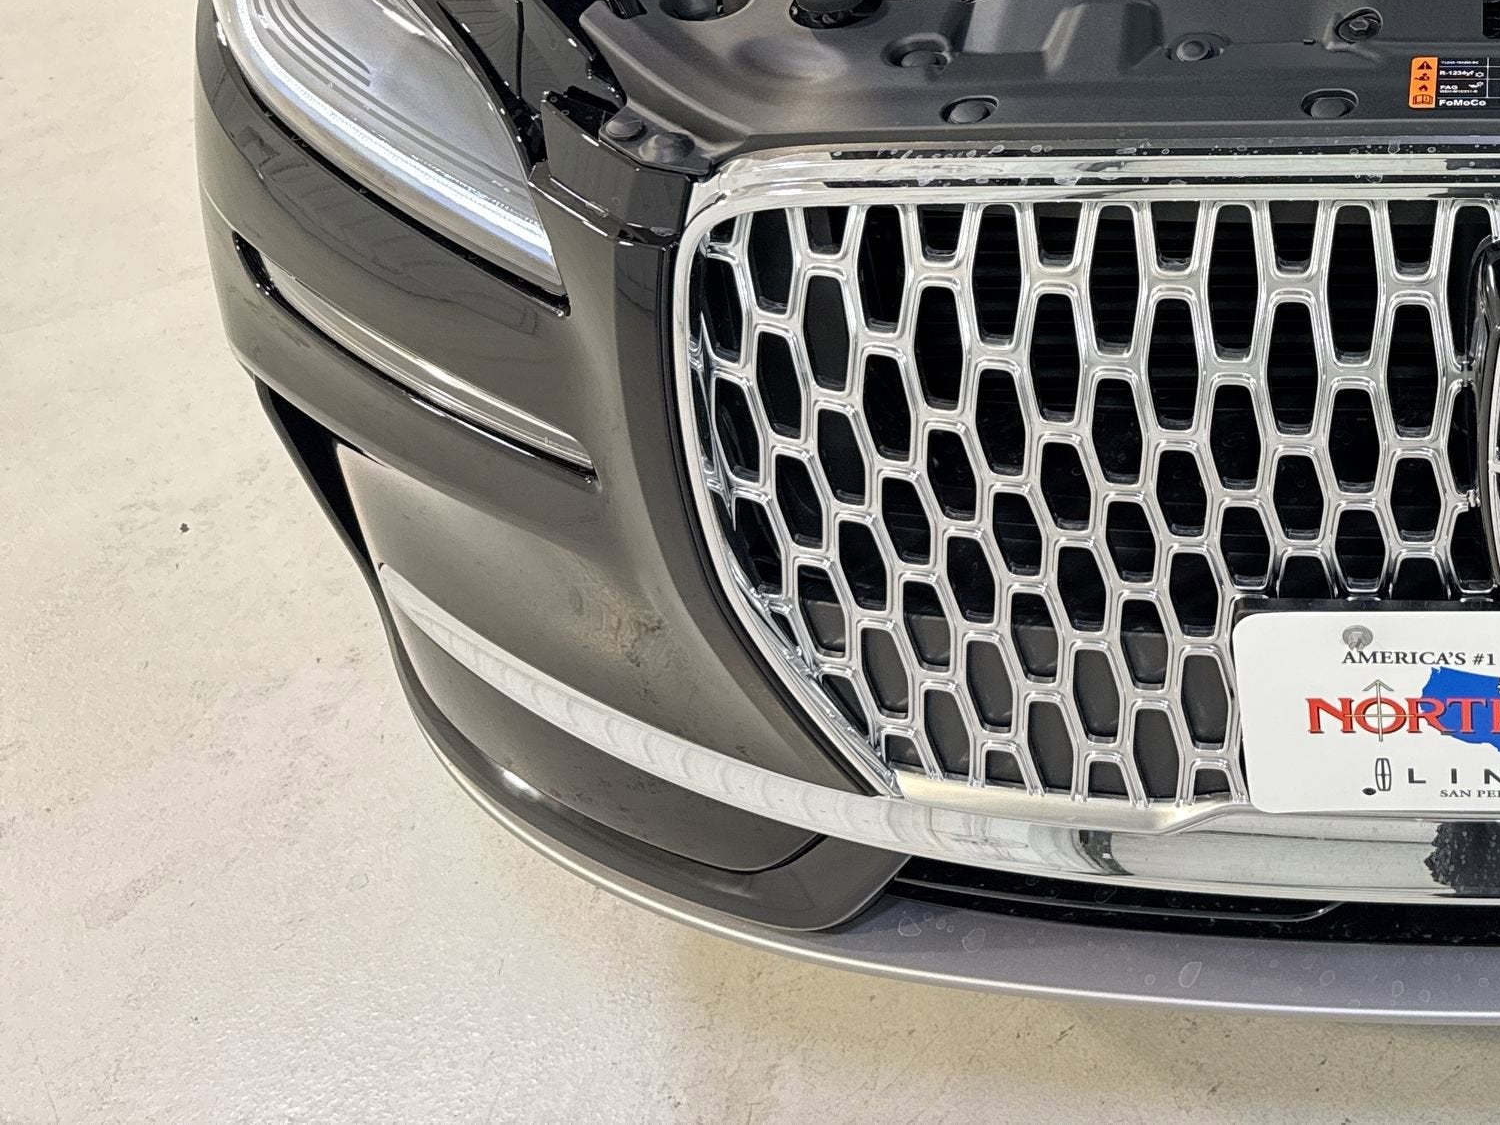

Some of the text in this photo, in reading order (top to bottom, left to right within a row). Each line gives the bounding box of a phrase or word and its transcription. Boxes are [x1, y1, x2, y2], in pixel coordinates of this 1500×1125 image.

[1439, 99, 1487, 107] FoMoCo
[1342, 650, 1467, 665] AMERICA'S
[1472, 652, 1496, 666] #1
[1440, 789, 1475, 798] SAN
